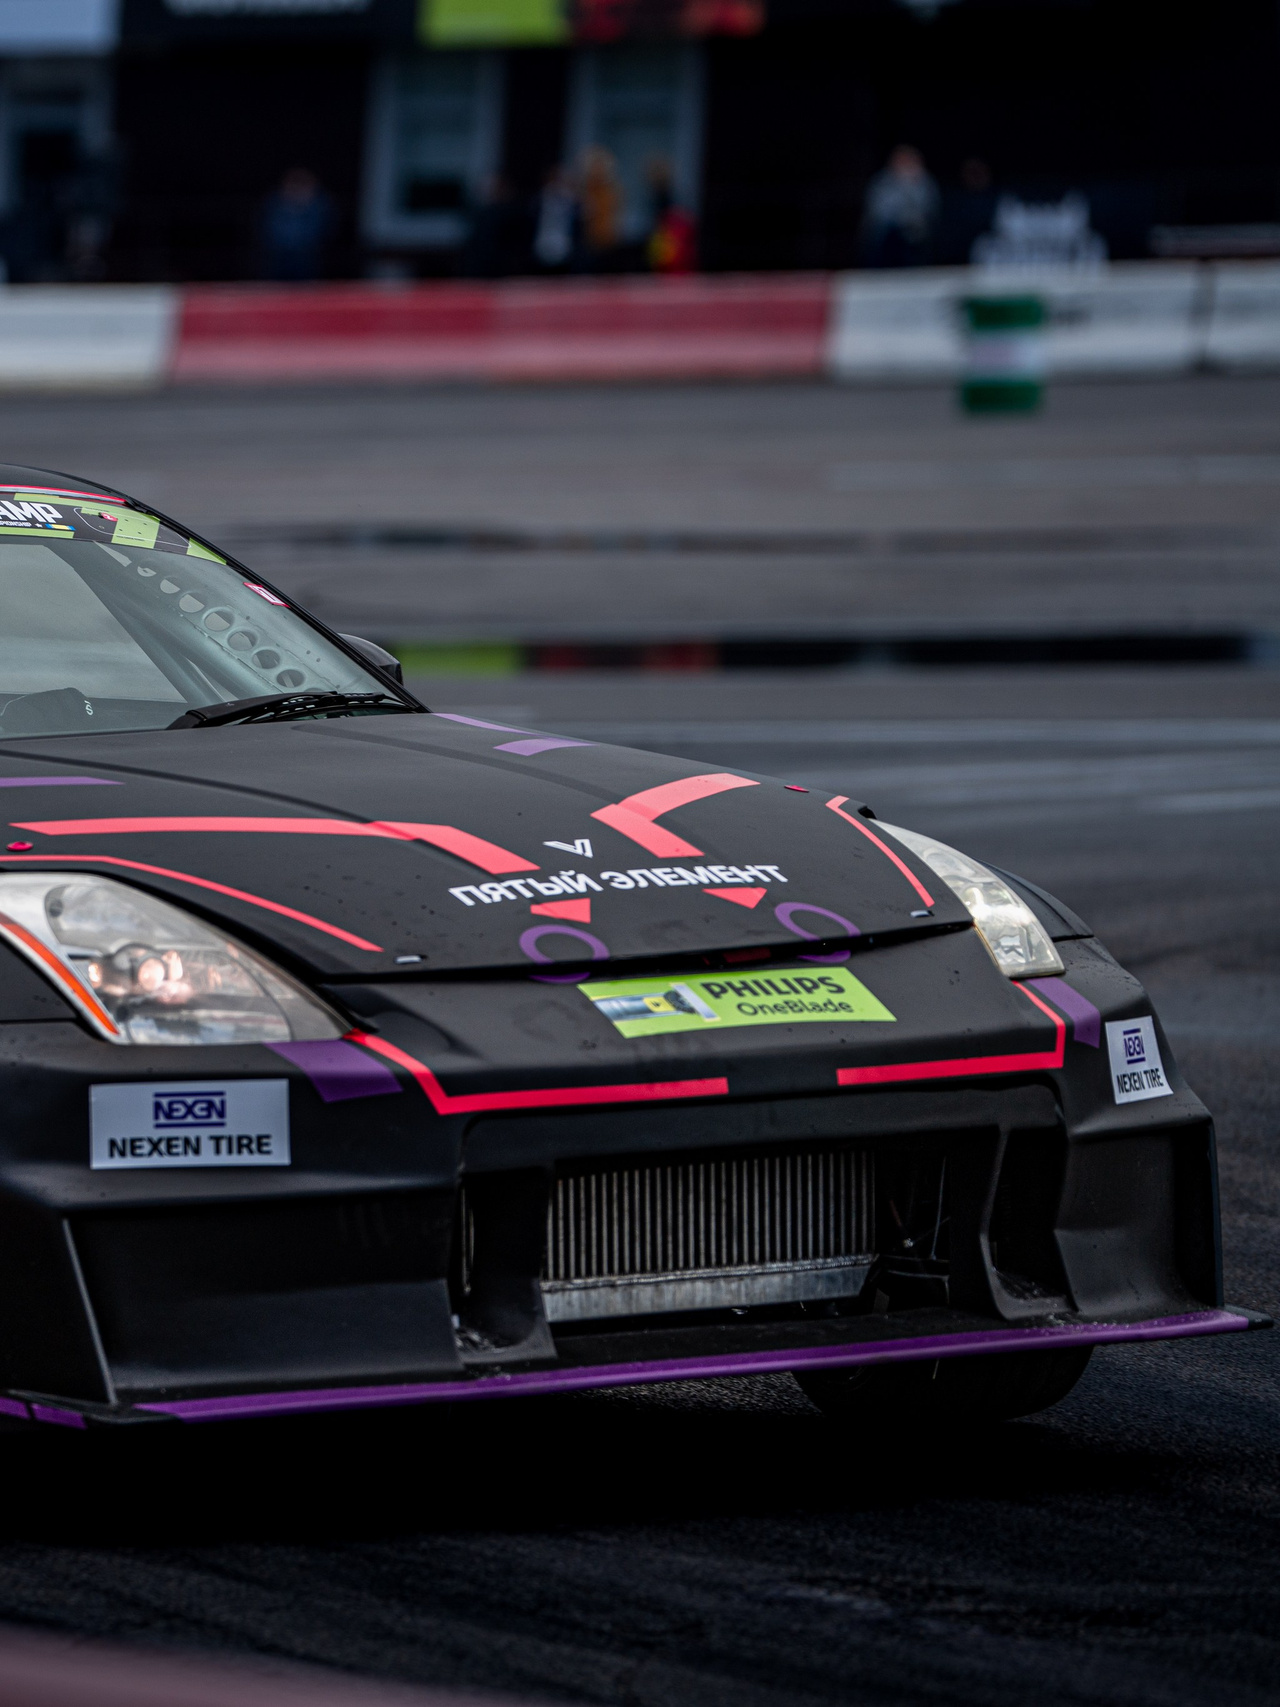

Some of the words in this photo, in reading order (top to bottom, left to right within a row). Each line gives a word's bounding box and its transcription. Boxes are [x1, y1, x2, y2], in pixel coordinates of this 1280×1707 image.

[448, 870, 604, 907] ПЯТЫЙ
[600, 864, 789, 890] ЭЛЕМЕНТ
[700, 976, 847, 999] PHILIPS
[736, 999, 855, 1016] OneBlade
[1116, 1071, 1146, 1094] NEXEN
[1143, 1067, 1164, 1090] TIRE
[154, 1098, 225, 1121] NEXEN
[108, 1136, 201, 1158] NEXEN
[209, 1135, 272, 1156] TIRE
